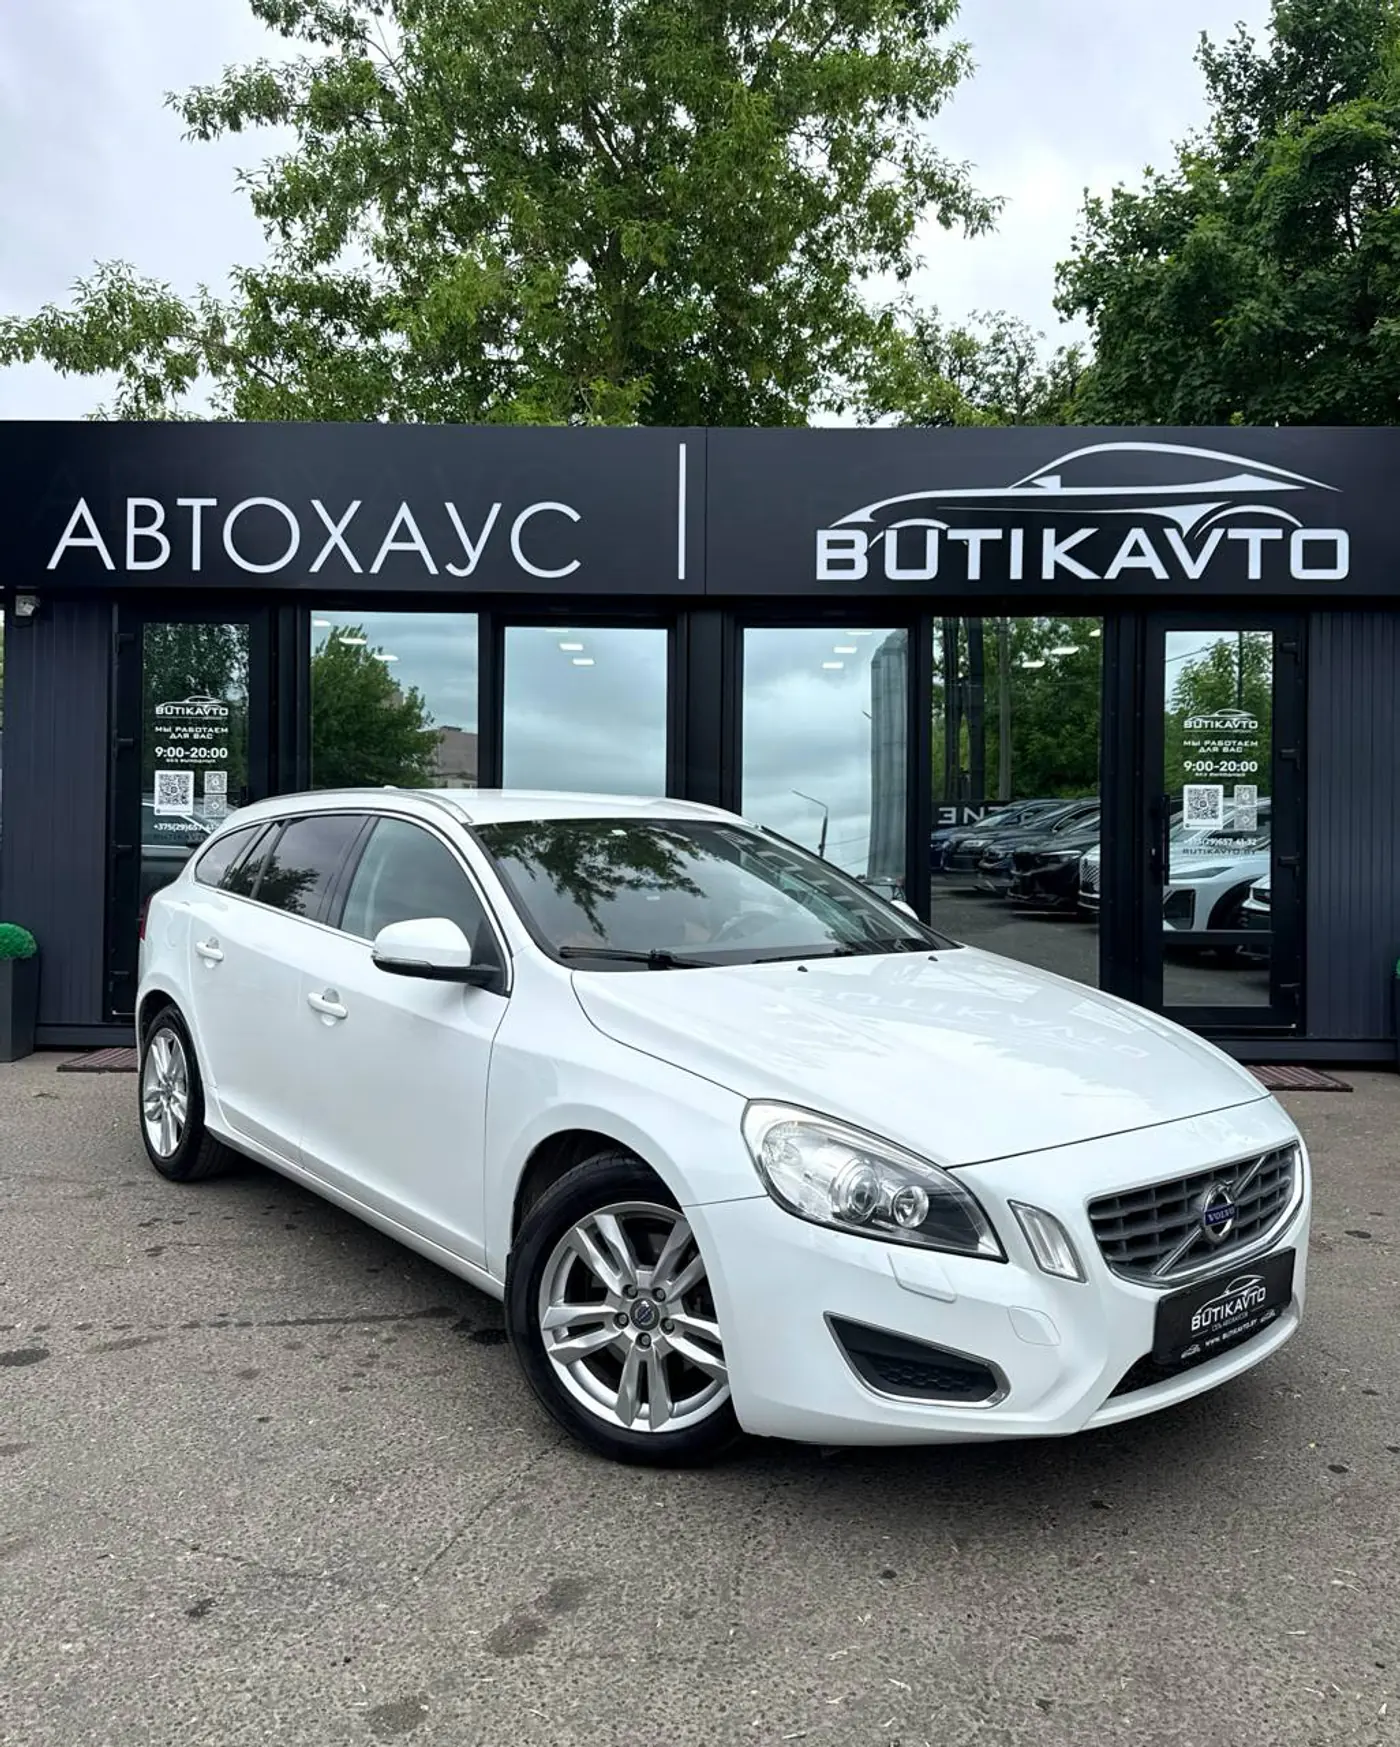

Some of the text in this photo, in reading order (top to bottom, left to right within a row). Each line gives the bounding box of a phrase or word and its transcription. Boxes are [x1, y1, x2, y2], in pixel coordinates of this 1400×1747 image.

[46, 496, 582, 579] АВТОХАУС
[816, 527, 1350, 581] BUTIKAVTO
[155, 705, 229, 716] BUTIKAVTO
[175, 726, 229, 734] РАБОТАЕМ
[1183, 720, 1258, 729] BUTIKAVTO
[155, 746, 228, 759] 9:00-20:00
[1183, 760, 1258, 772] 9:00-20:00
[1191, 1287, 1267, 1331] BUTIKAVTO
